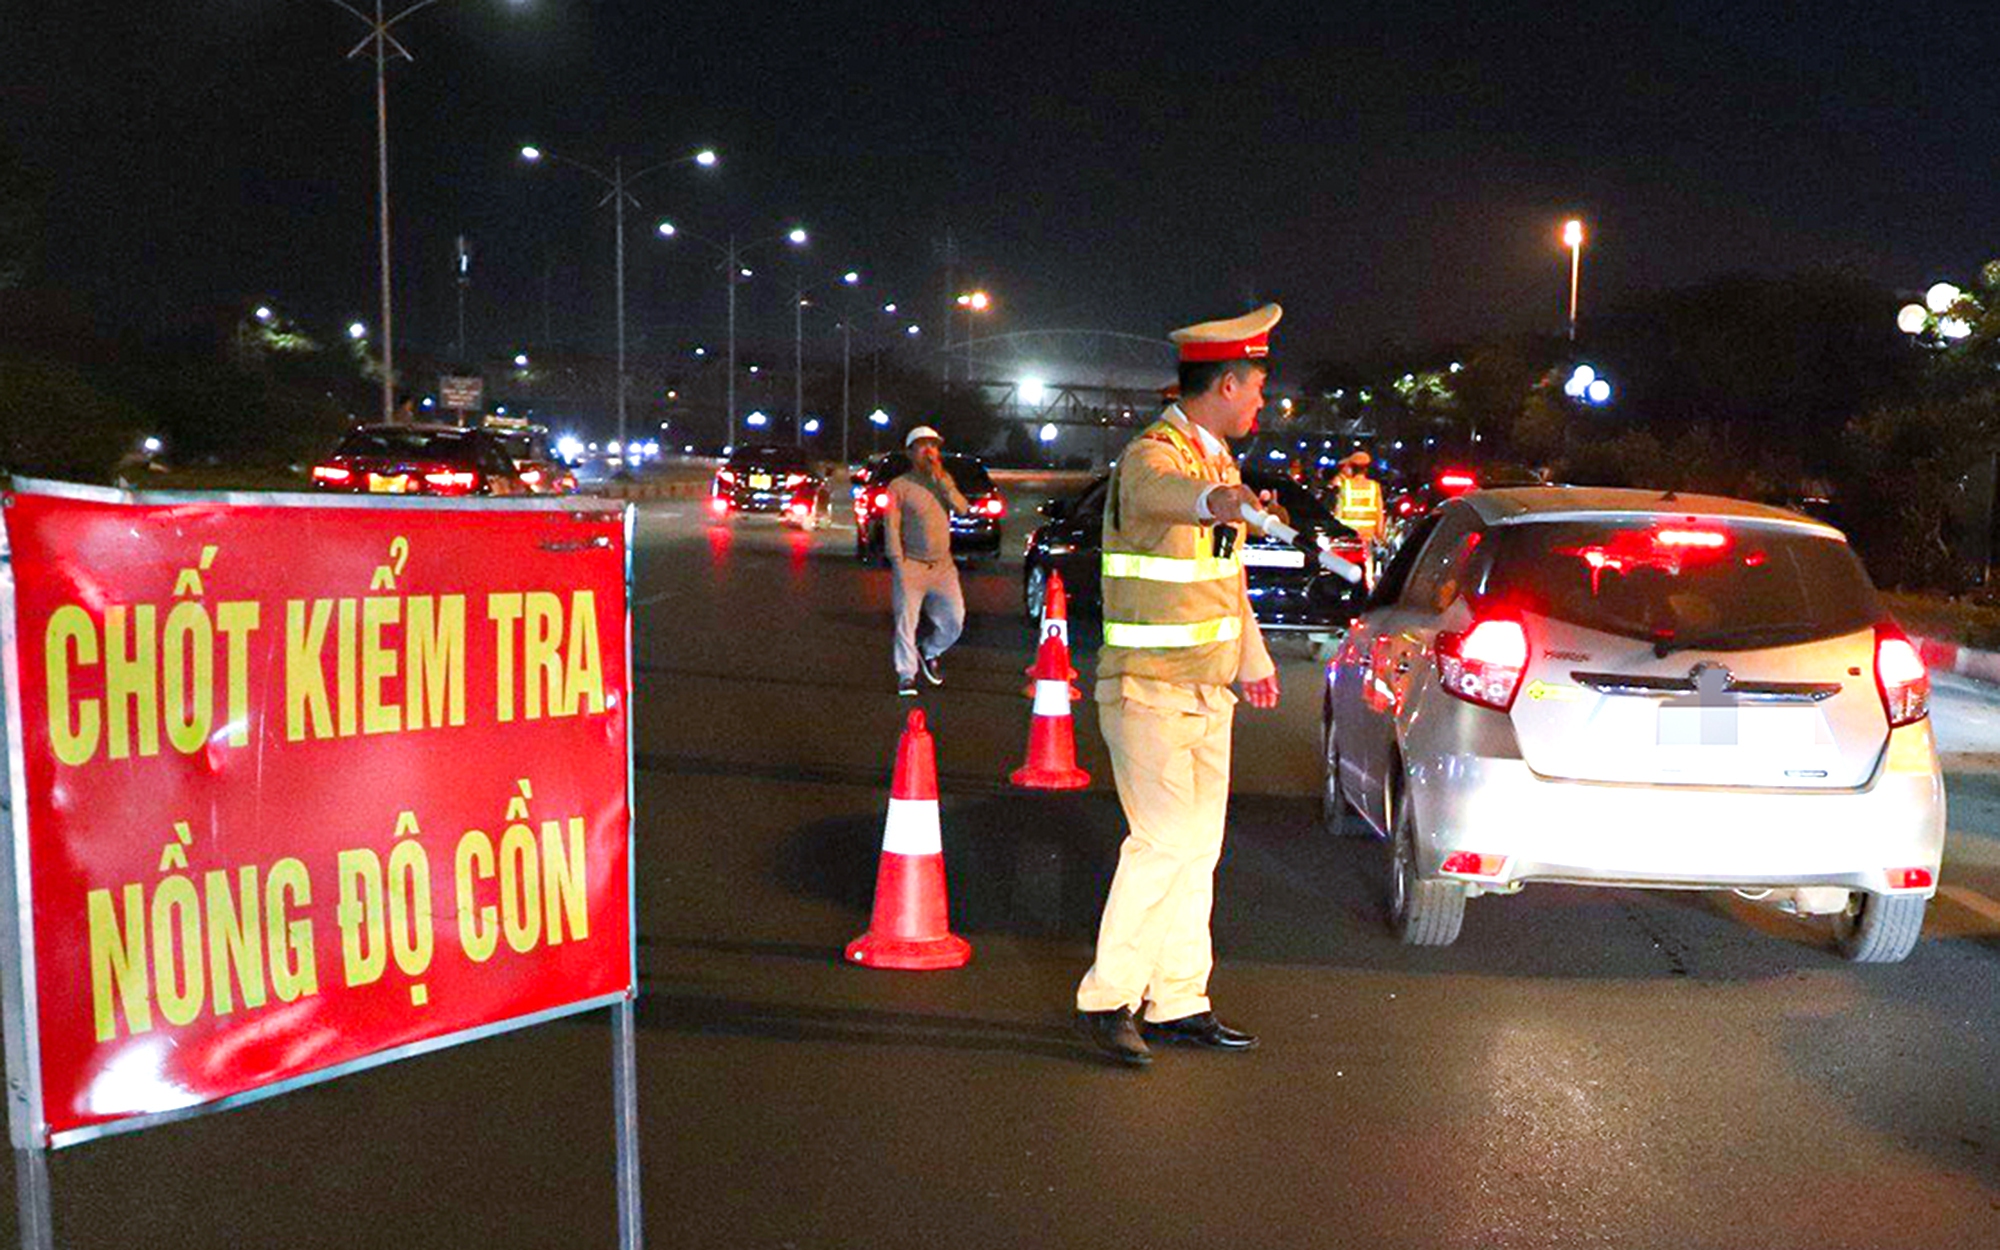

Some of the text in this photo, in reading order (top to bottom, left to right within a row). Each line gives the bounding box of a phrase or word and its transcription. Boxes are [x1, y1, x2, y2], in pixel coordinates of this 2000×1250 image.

[46, 537, 605, 766] CHỐT KIỂM TRA
[88, 778, 588, 1043] NỒNG ĐỘ CỒN
